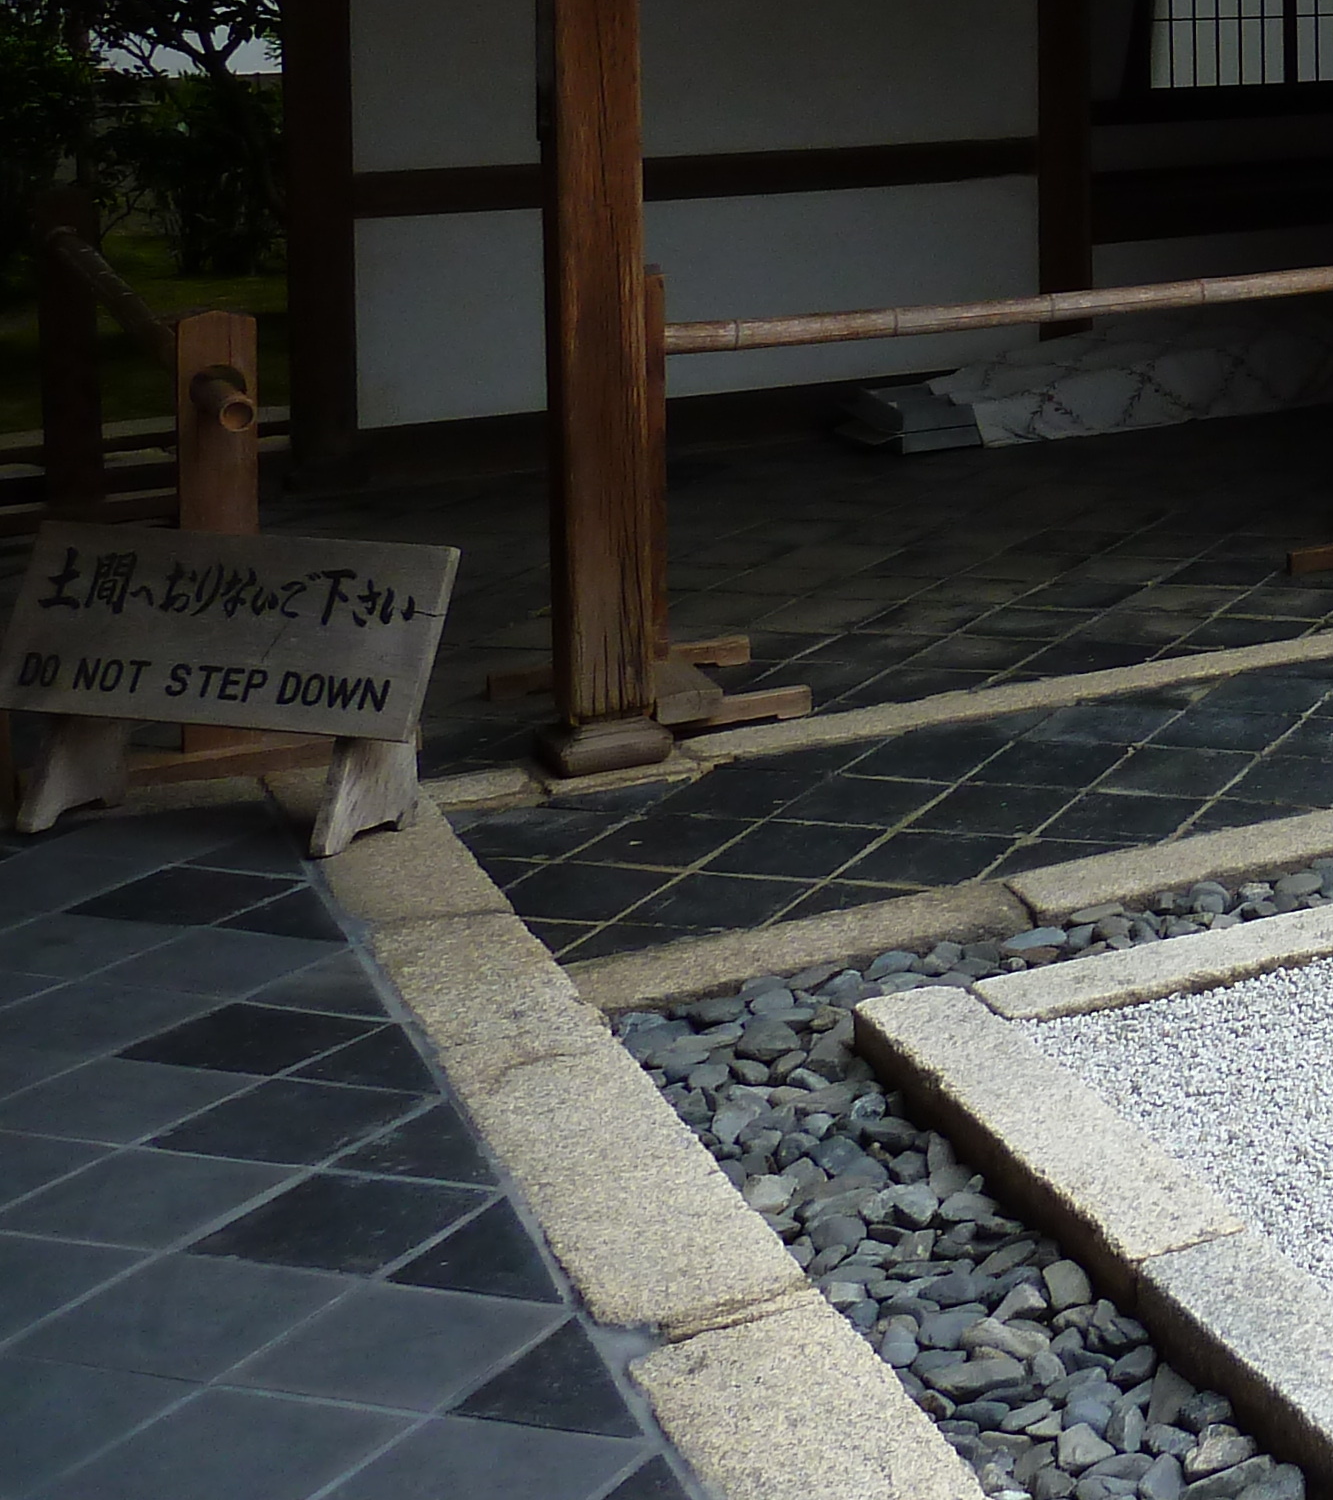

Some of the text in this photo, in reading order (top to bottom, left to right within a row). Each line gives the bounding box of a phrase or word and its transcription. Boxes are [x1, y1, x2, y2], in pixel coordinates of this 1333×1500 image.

[38, 545, 416, 627] 土間へおりないで下さい
[18, 652, 391, 713] DO NOT STEP DOWN
